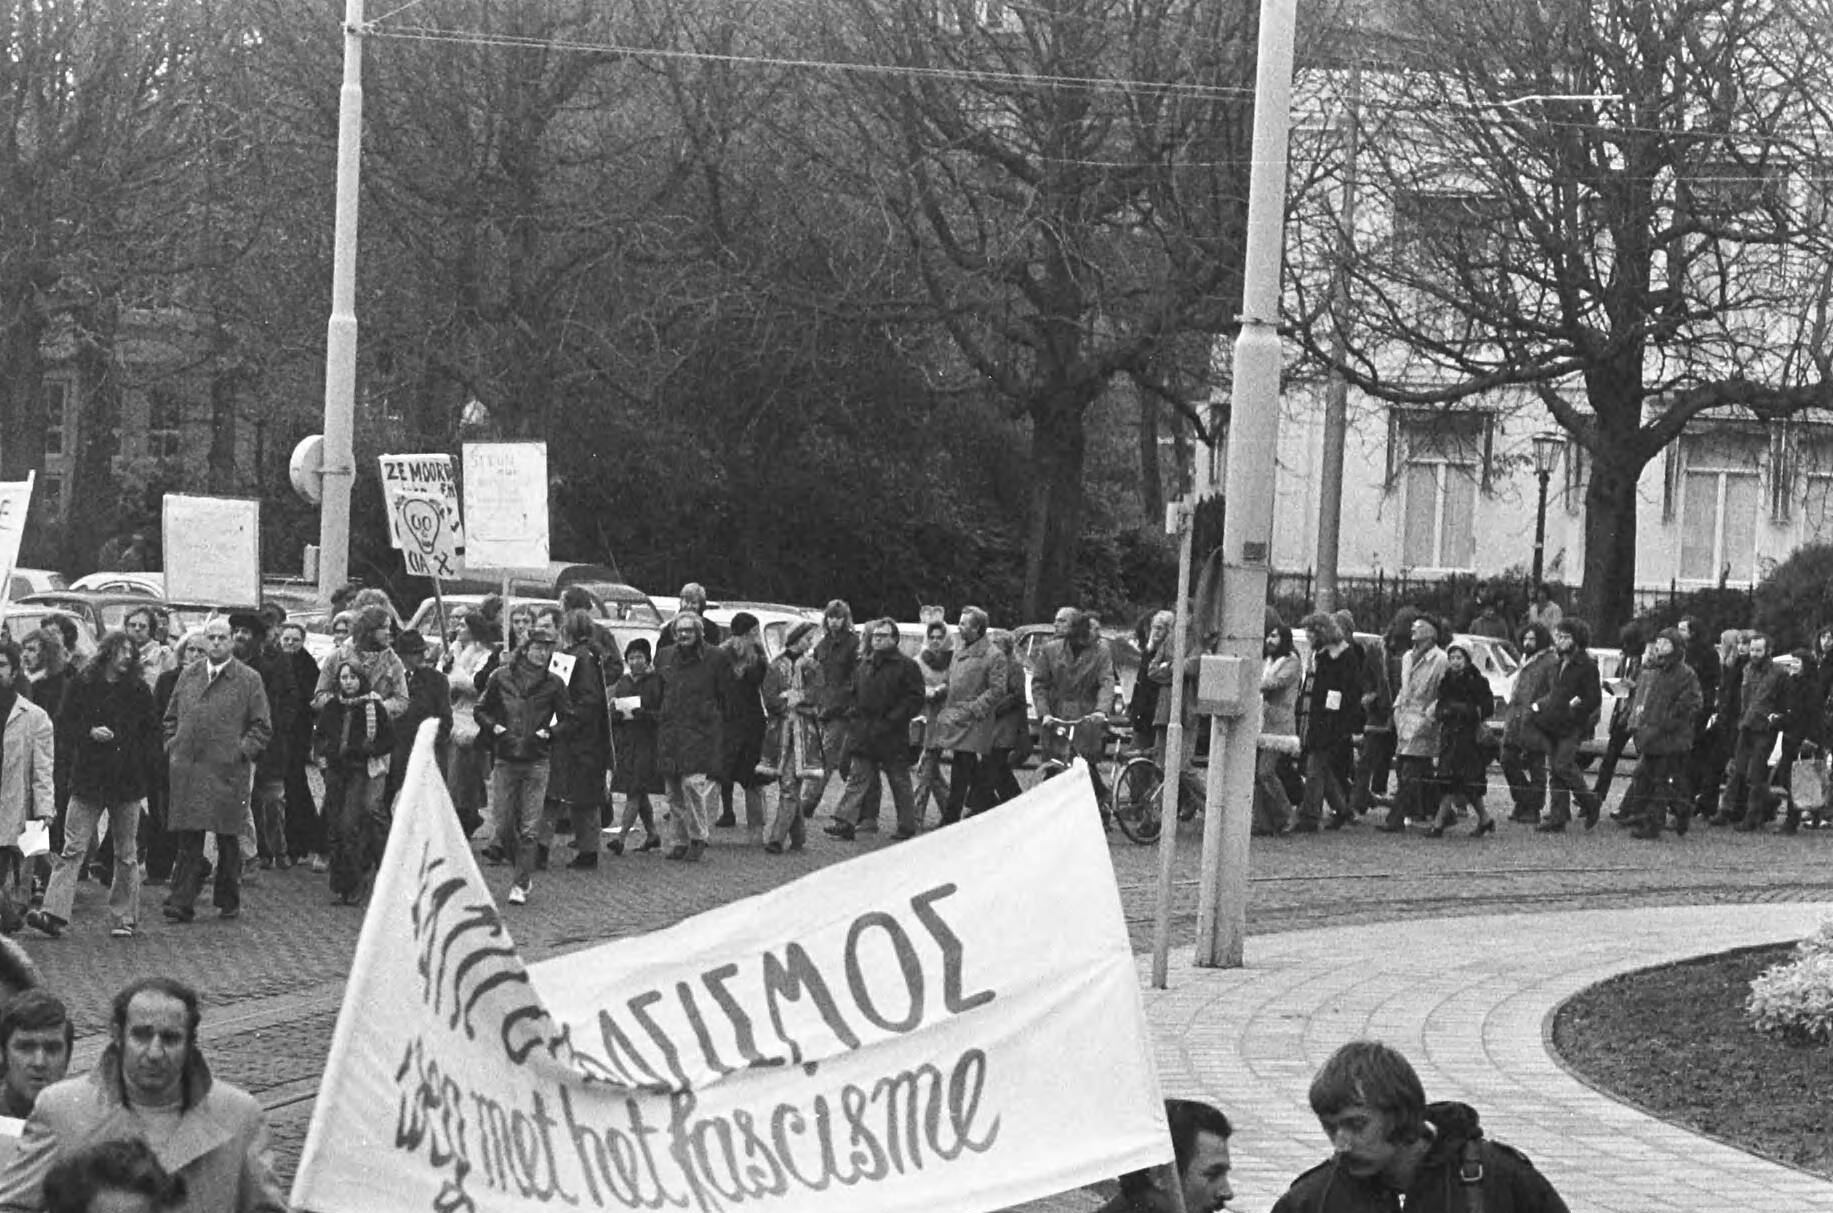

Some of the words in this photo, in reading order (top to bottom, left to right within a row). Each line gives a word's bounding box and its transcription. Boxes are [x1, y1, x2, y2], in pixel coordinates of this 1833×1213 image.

[384, 462, 408, 481] ZE
[470, 1089, 579, 1206] met
[559, 1082, 689, 1208] het
